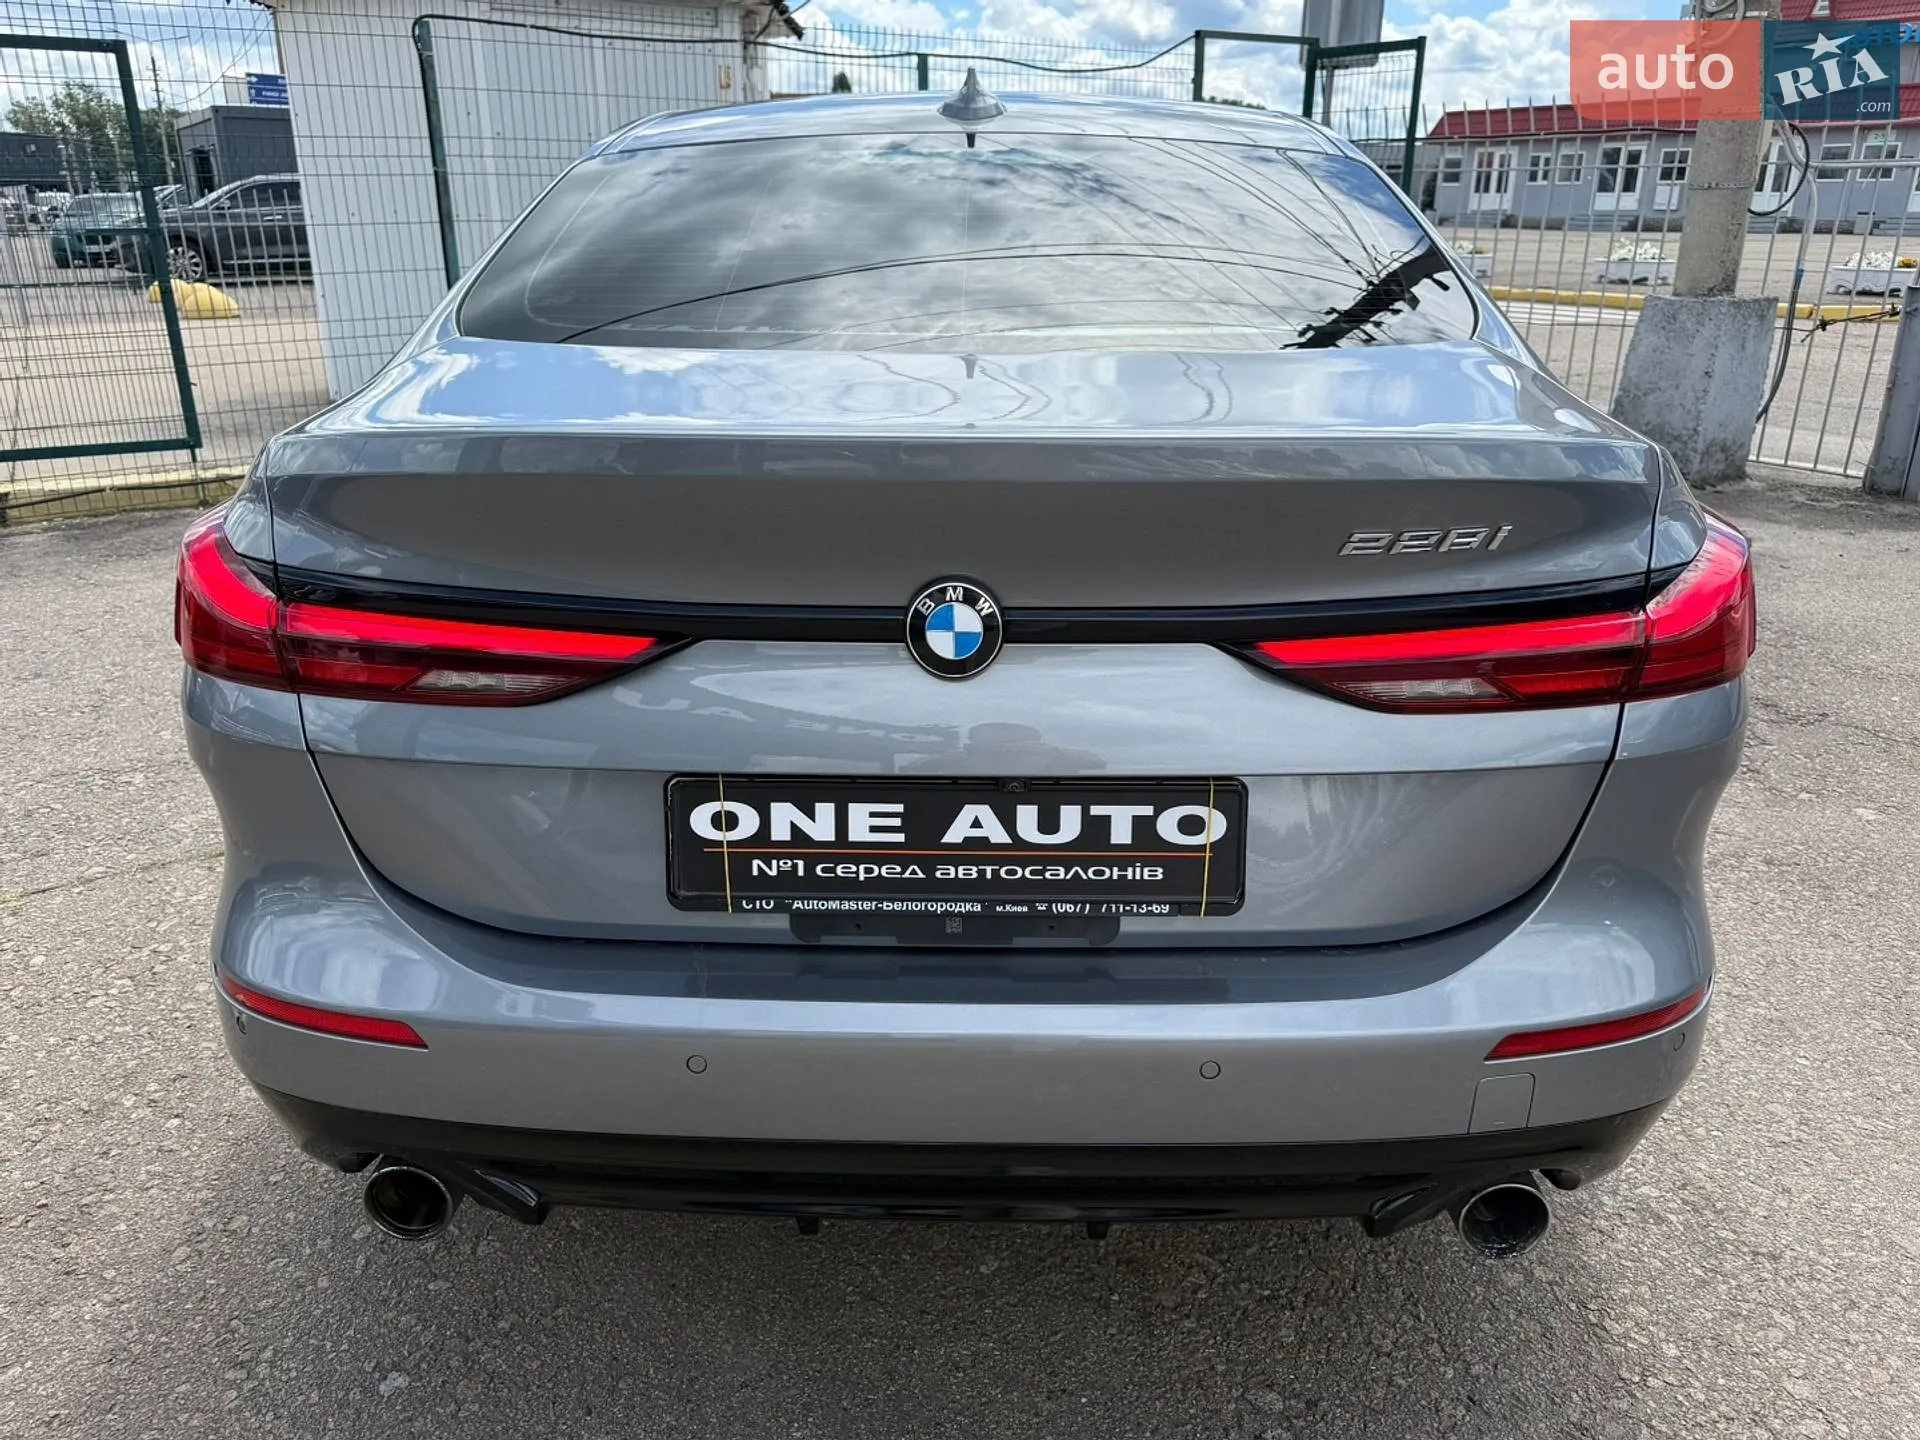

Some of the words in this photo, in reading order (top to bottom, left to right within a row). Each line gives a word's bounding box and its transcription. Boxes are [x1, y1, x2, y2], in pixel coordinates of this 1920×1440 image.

[1338, 523, 1513, 556] 228i
[916, 586, 995, 617] BMW
[689, 801, 905, 842] ONE
[940, 803, 1227, 845] AUTO
[751, 859, 805, 877] №1
[815, 863, 926, 881] серед
[934, 862, 1164, 881] автосалонів
